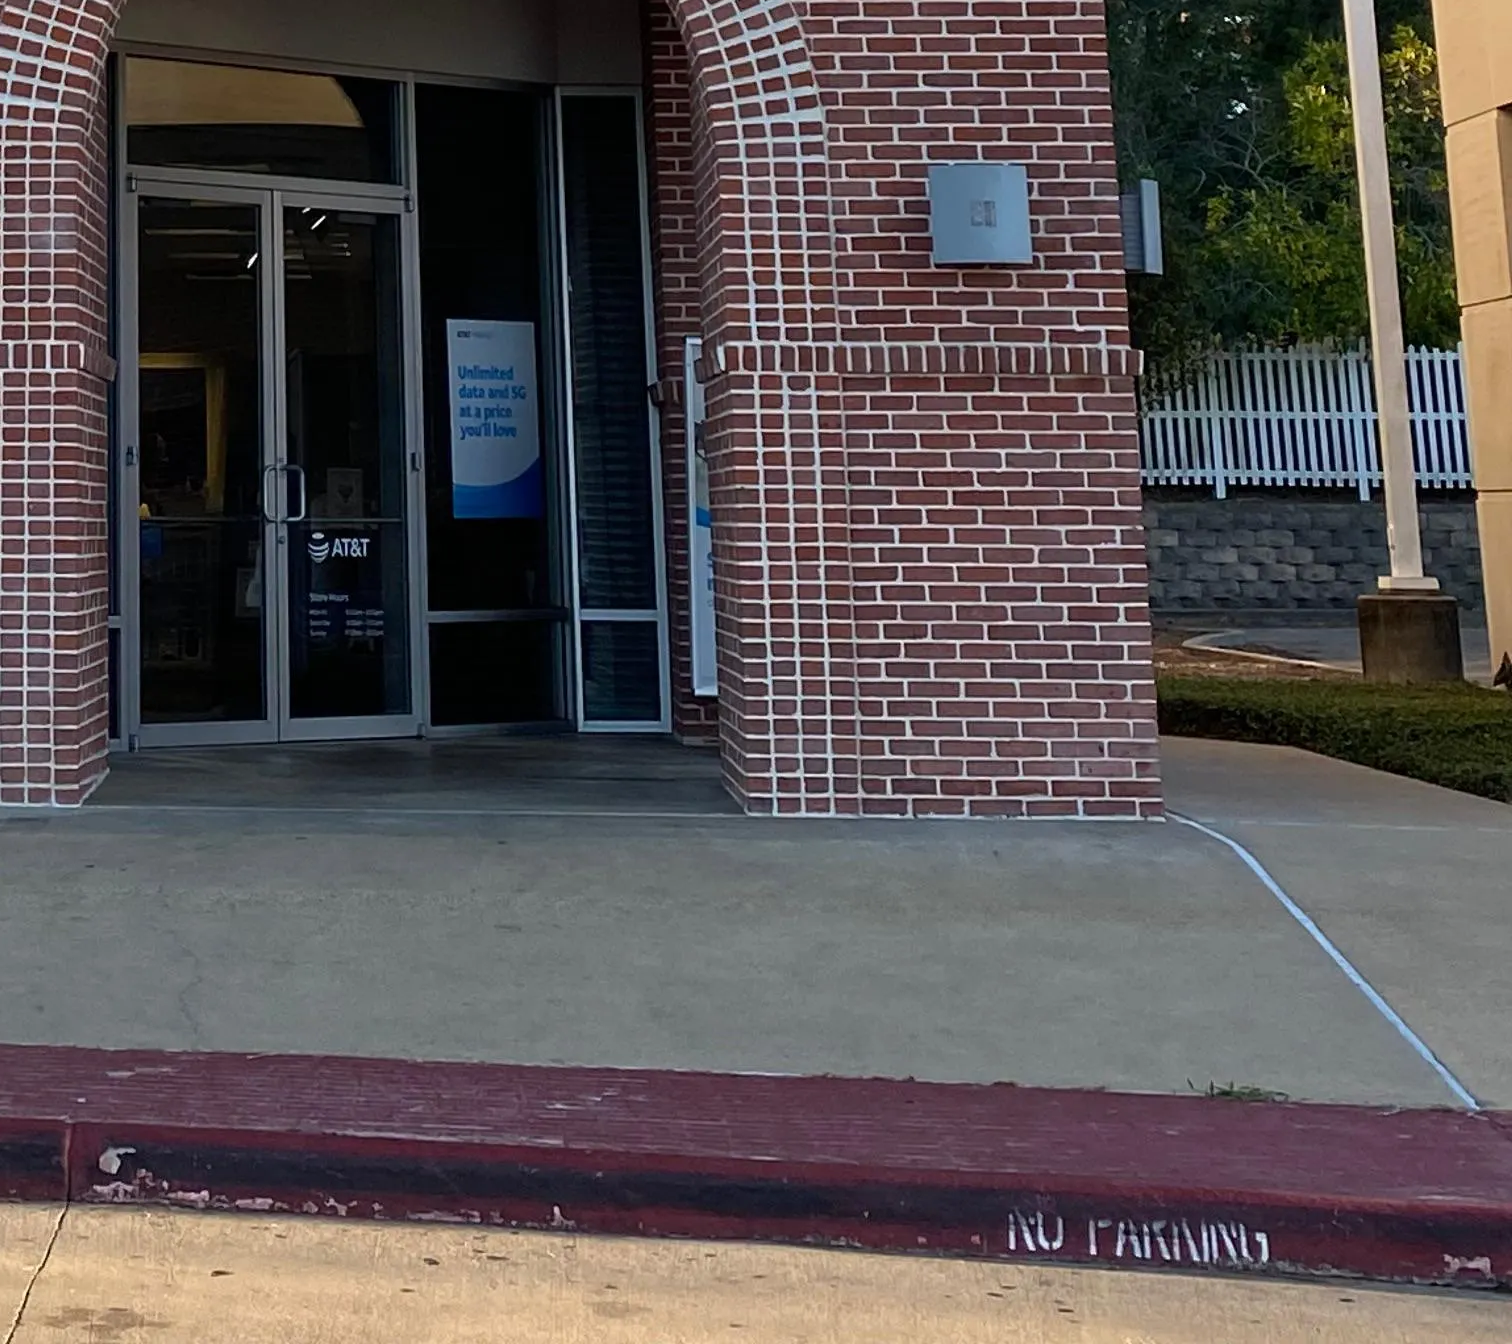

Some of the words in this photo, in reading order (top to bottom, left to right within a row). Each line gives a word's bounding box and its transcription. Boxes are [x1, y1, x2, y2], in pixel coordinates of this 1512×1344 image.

[457, 365, 514, 380] Unlimited
[458, 385, 485, 399] data
[488, 385, 509, 399] and
[511, 386, 526, 399] 5G
[483, 404, 512, 421] price
[493, 423, 517, 437] love
[331, 538, 370, 557] AT&T
[1007, 1209, 1064, 1251] NO
